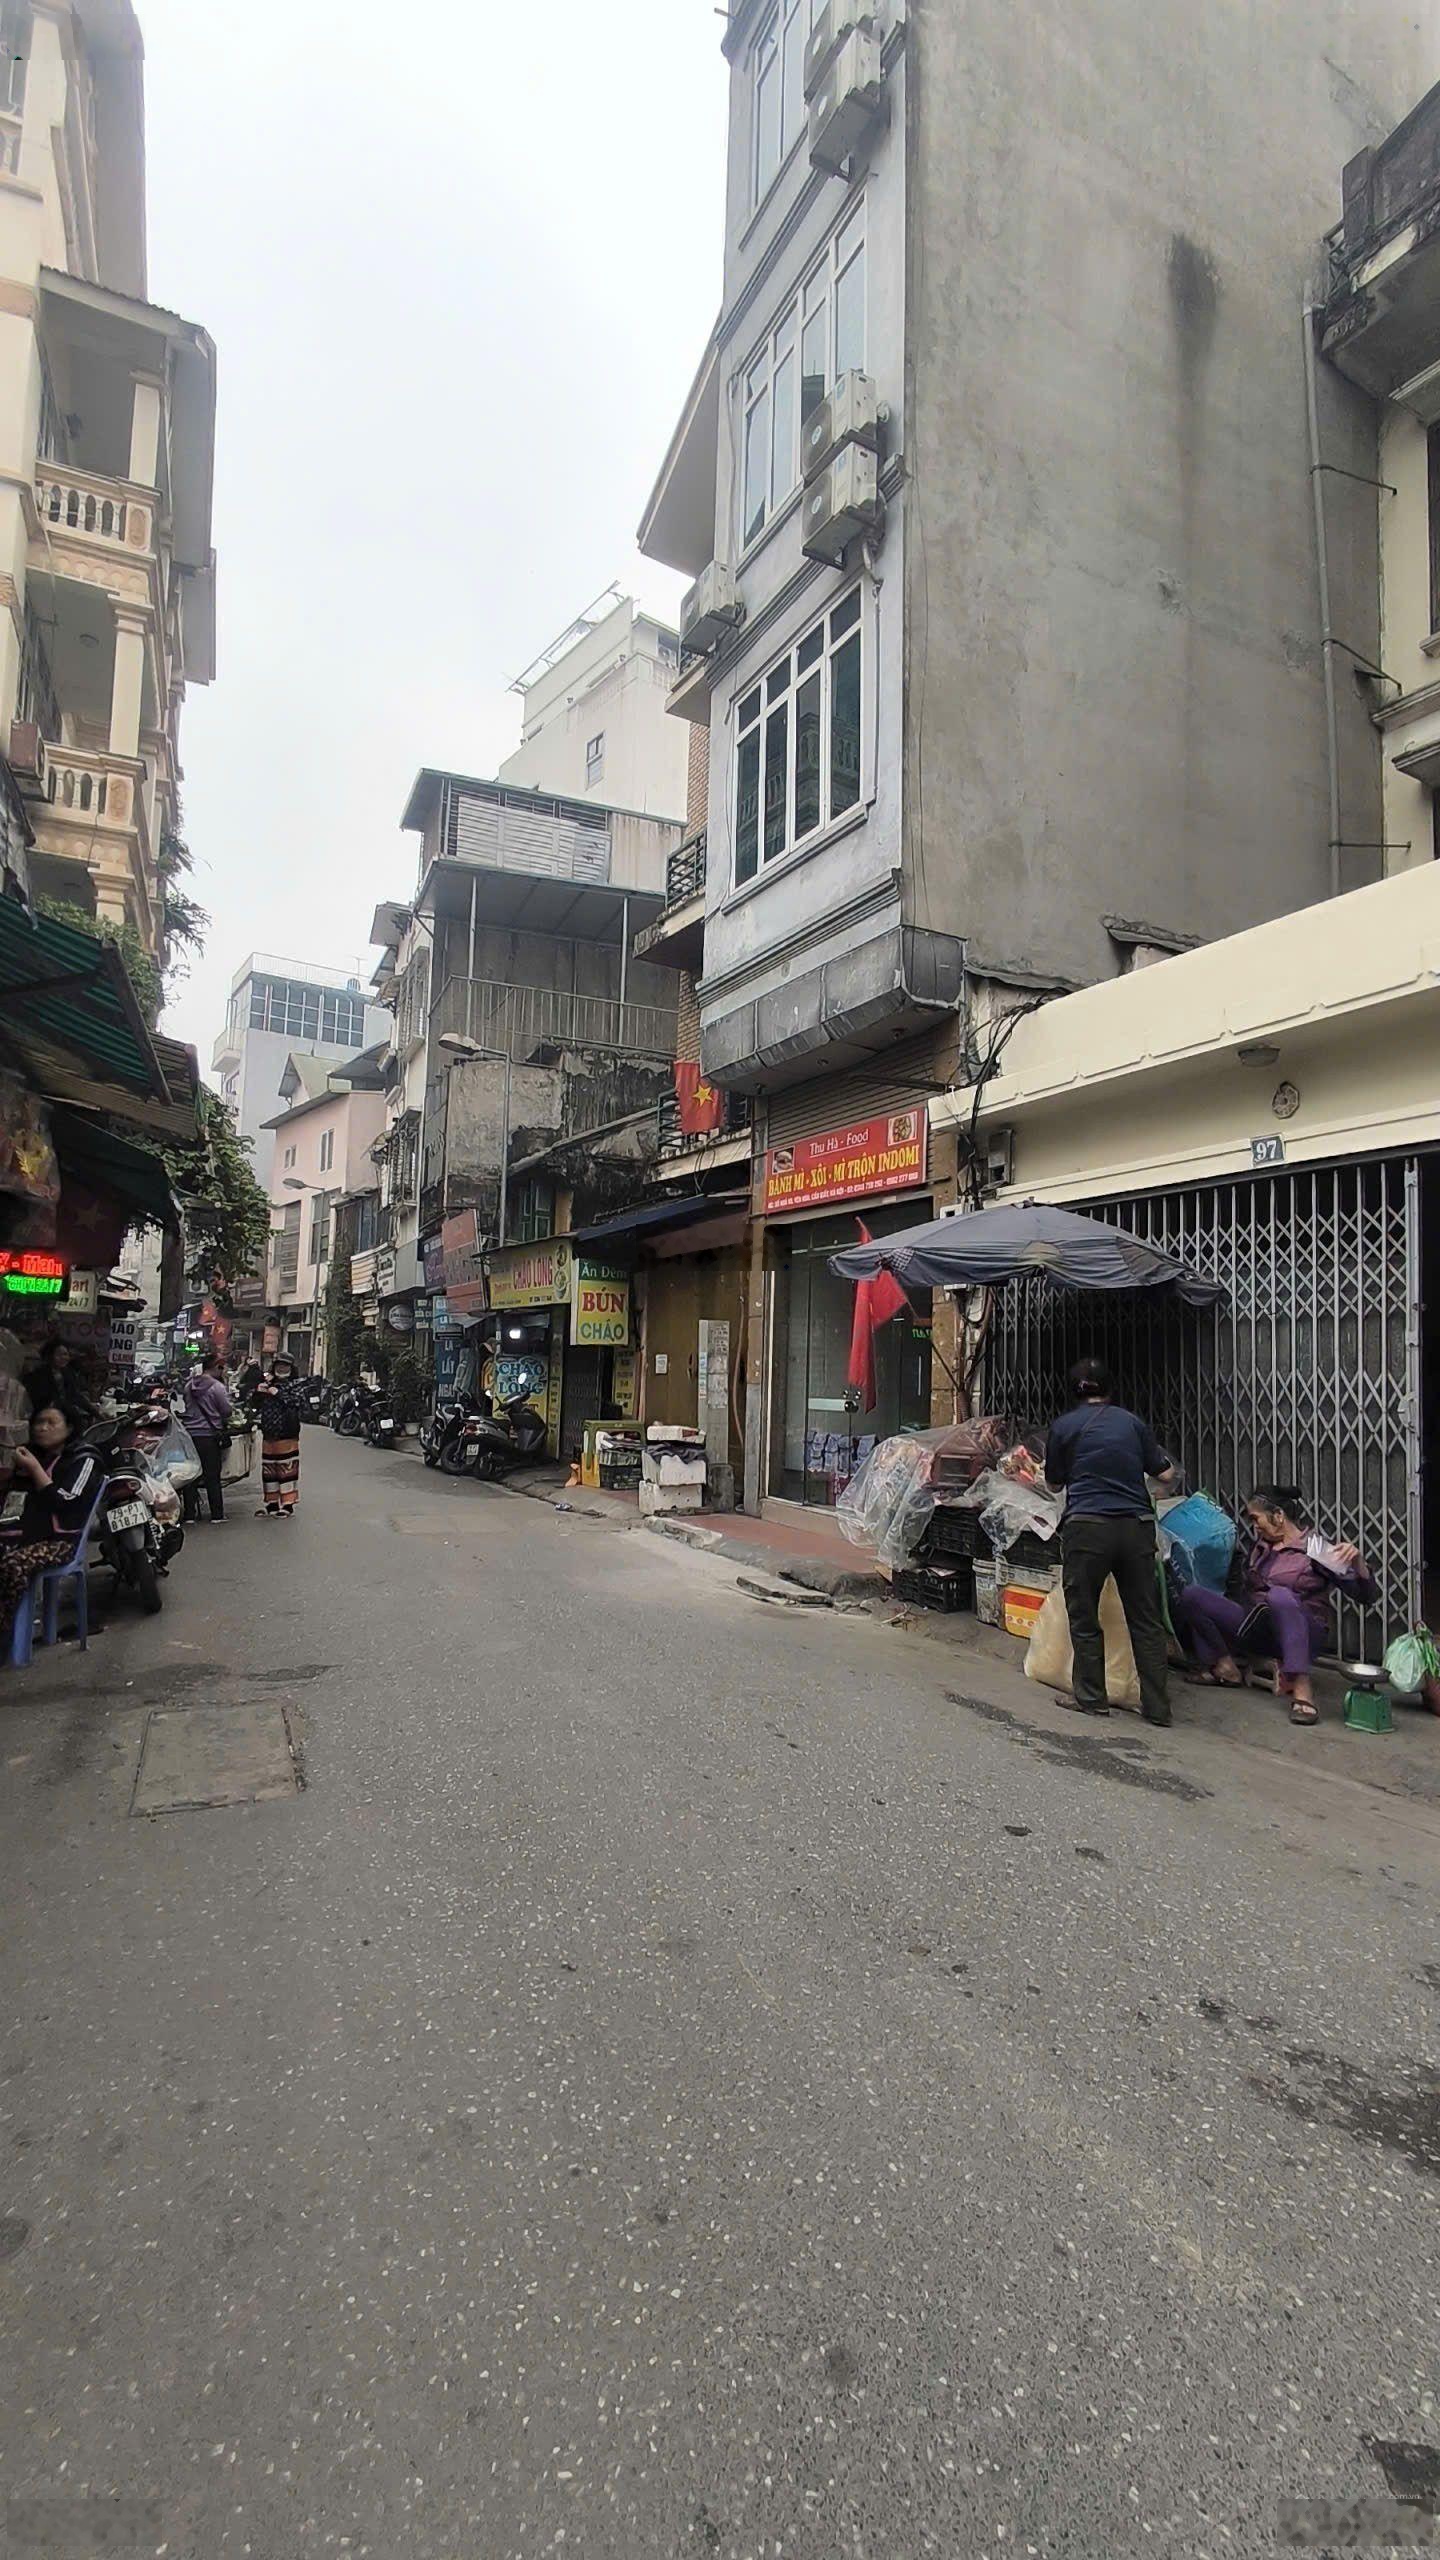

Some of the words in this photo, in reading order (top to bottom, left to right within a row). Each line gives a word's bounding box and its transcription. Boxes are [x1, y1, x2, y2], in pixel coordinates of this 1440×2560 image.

[809, 1142, 825, 1156] Thu
[826, 1136, 839, 1149] Hà
[847, 1127, 869, 1145] Food
[1254, 1139, 1277, 1162] 97
[768, 1172, 792, 1197] BÁNH
[793, 1167, 805, 1190] MÌ
[810, 1163, 827, 1188] XÔI
[833, 1160, 846, 1183] MÌ
[847, 1152, 876, 1184] TRỘN
[878, 1144, 920, 1173] INDOMI
[581, 1262, 597, 1278] Ăn
[582, 1287, 626, 1313] BÚN
